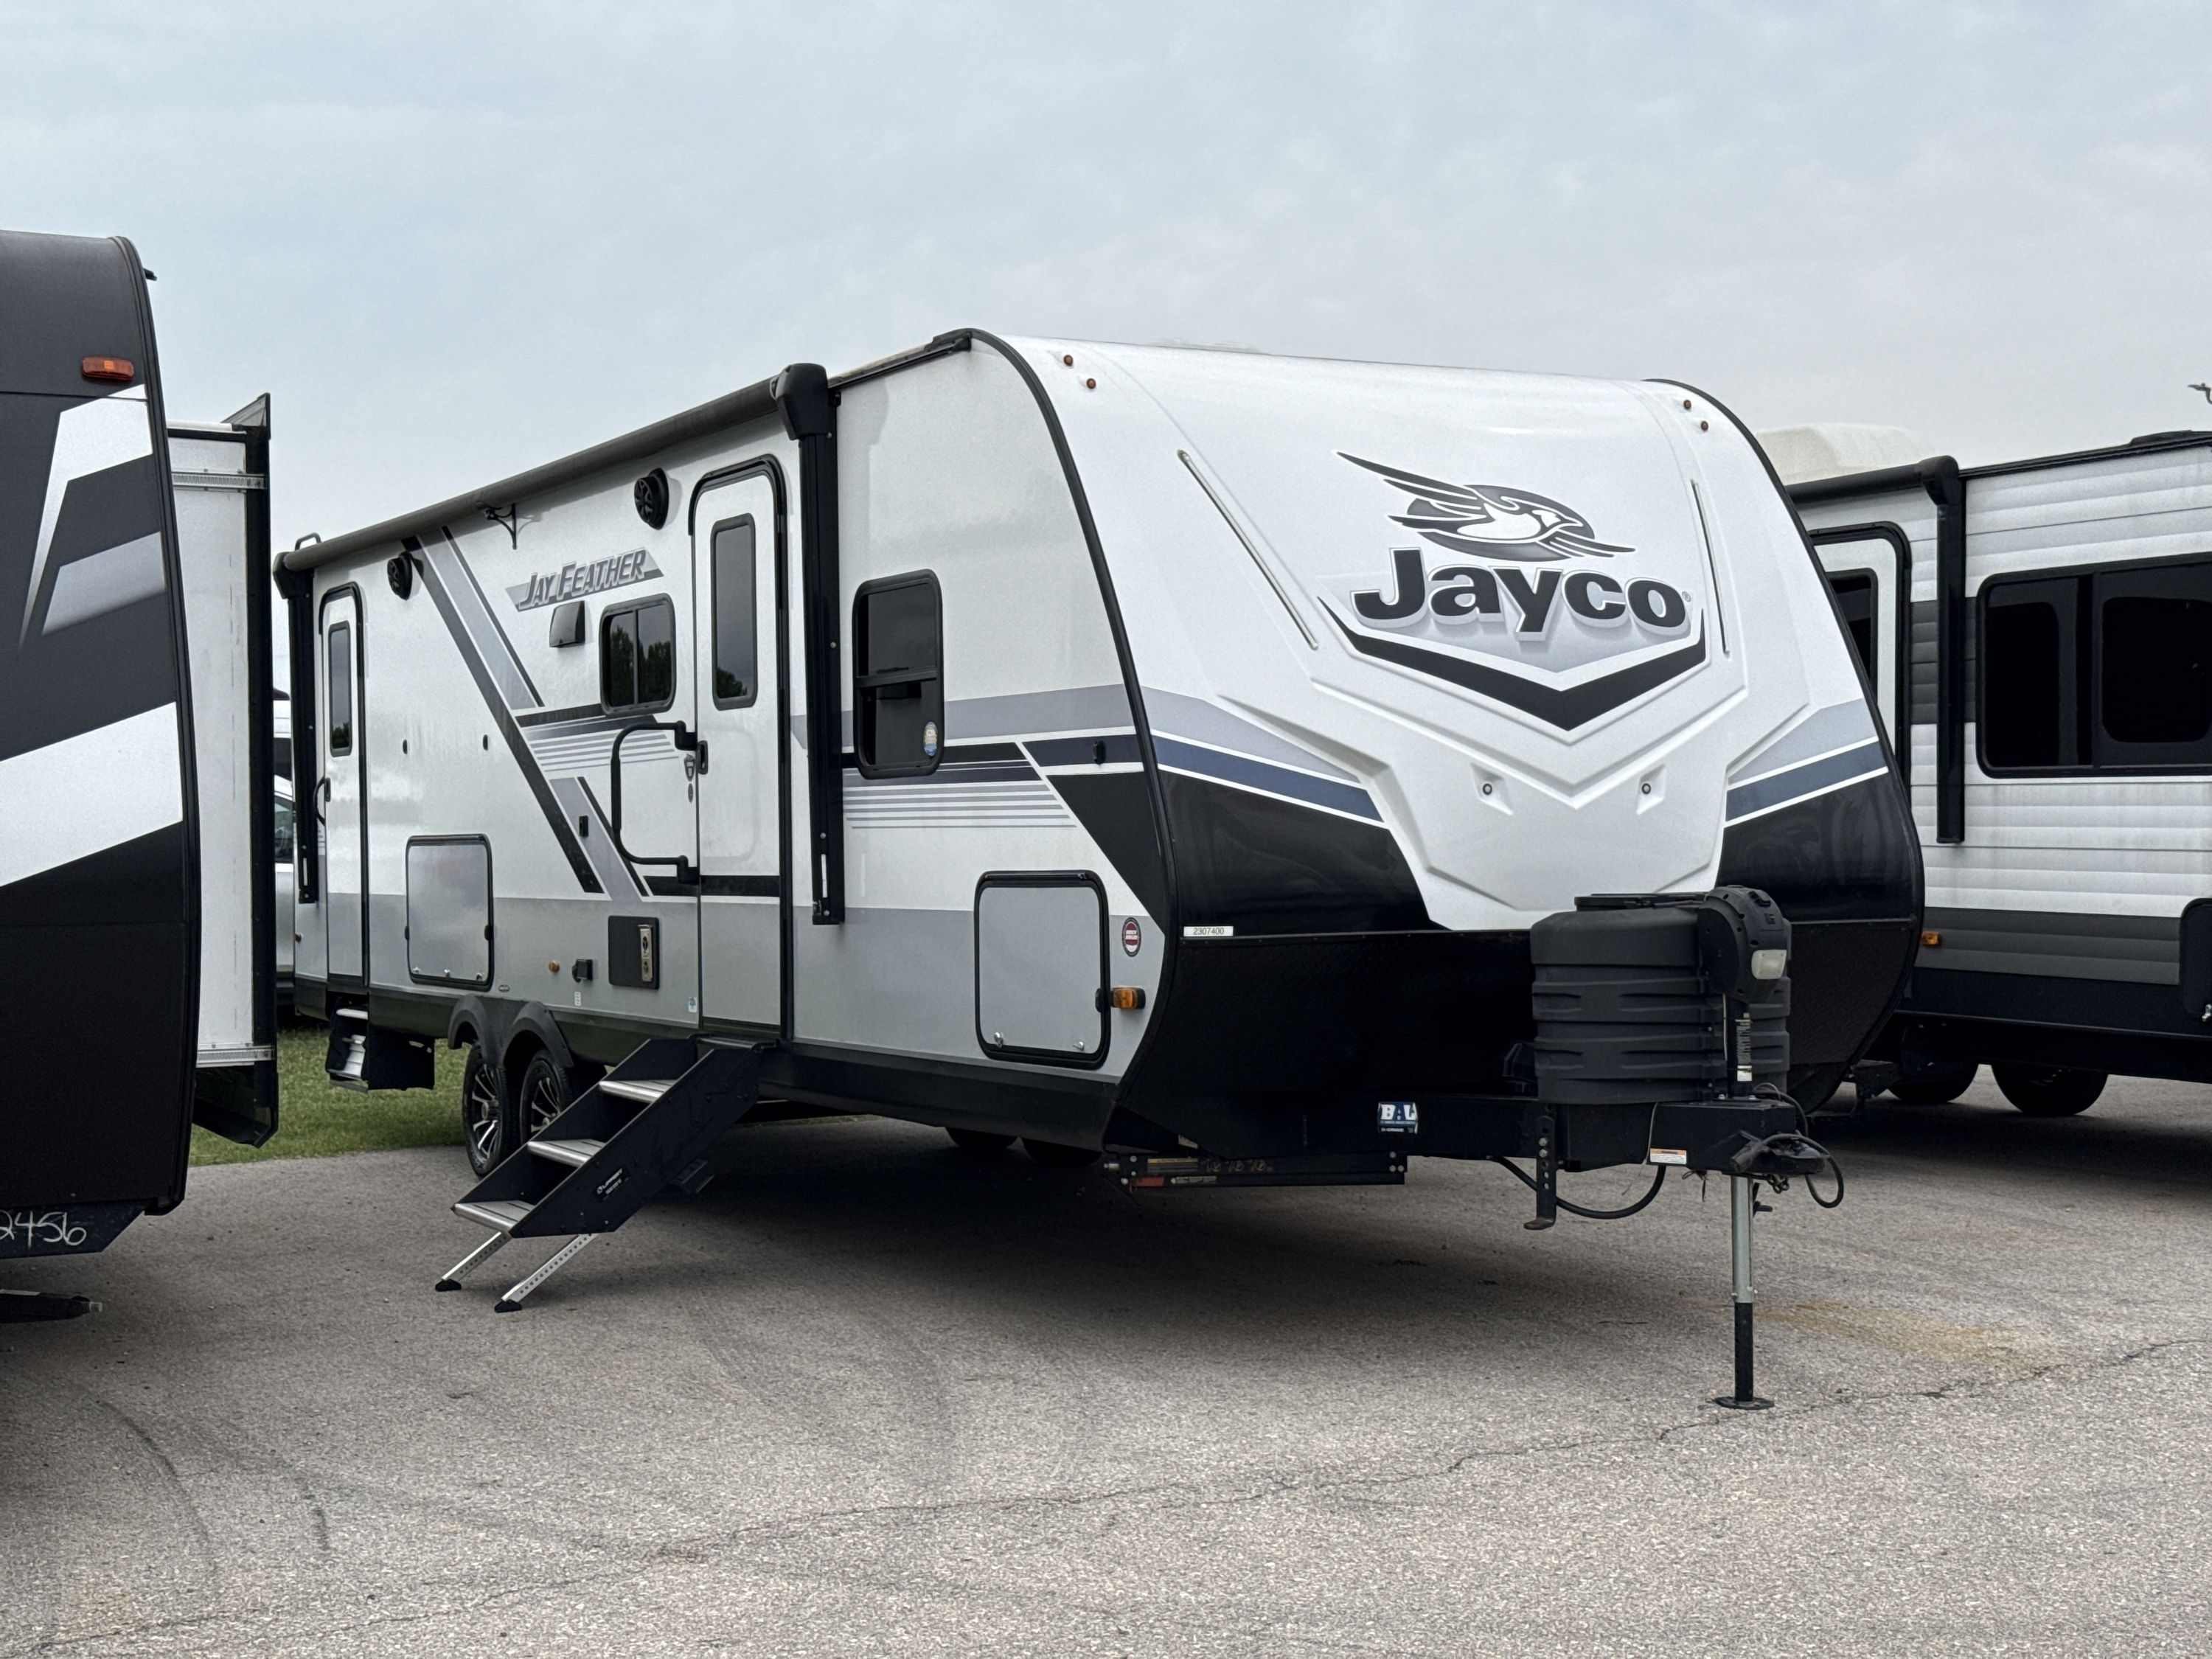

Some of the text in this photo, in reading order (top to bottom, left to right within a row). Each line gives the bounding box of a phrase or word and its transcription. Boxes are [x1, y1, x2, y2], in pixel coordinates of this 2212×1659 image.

[557, 548, 647, 600] FEATHER
[1350, 547, 1688, 639] Jayco
[1380, 1104, 1416, 1120] BAL
